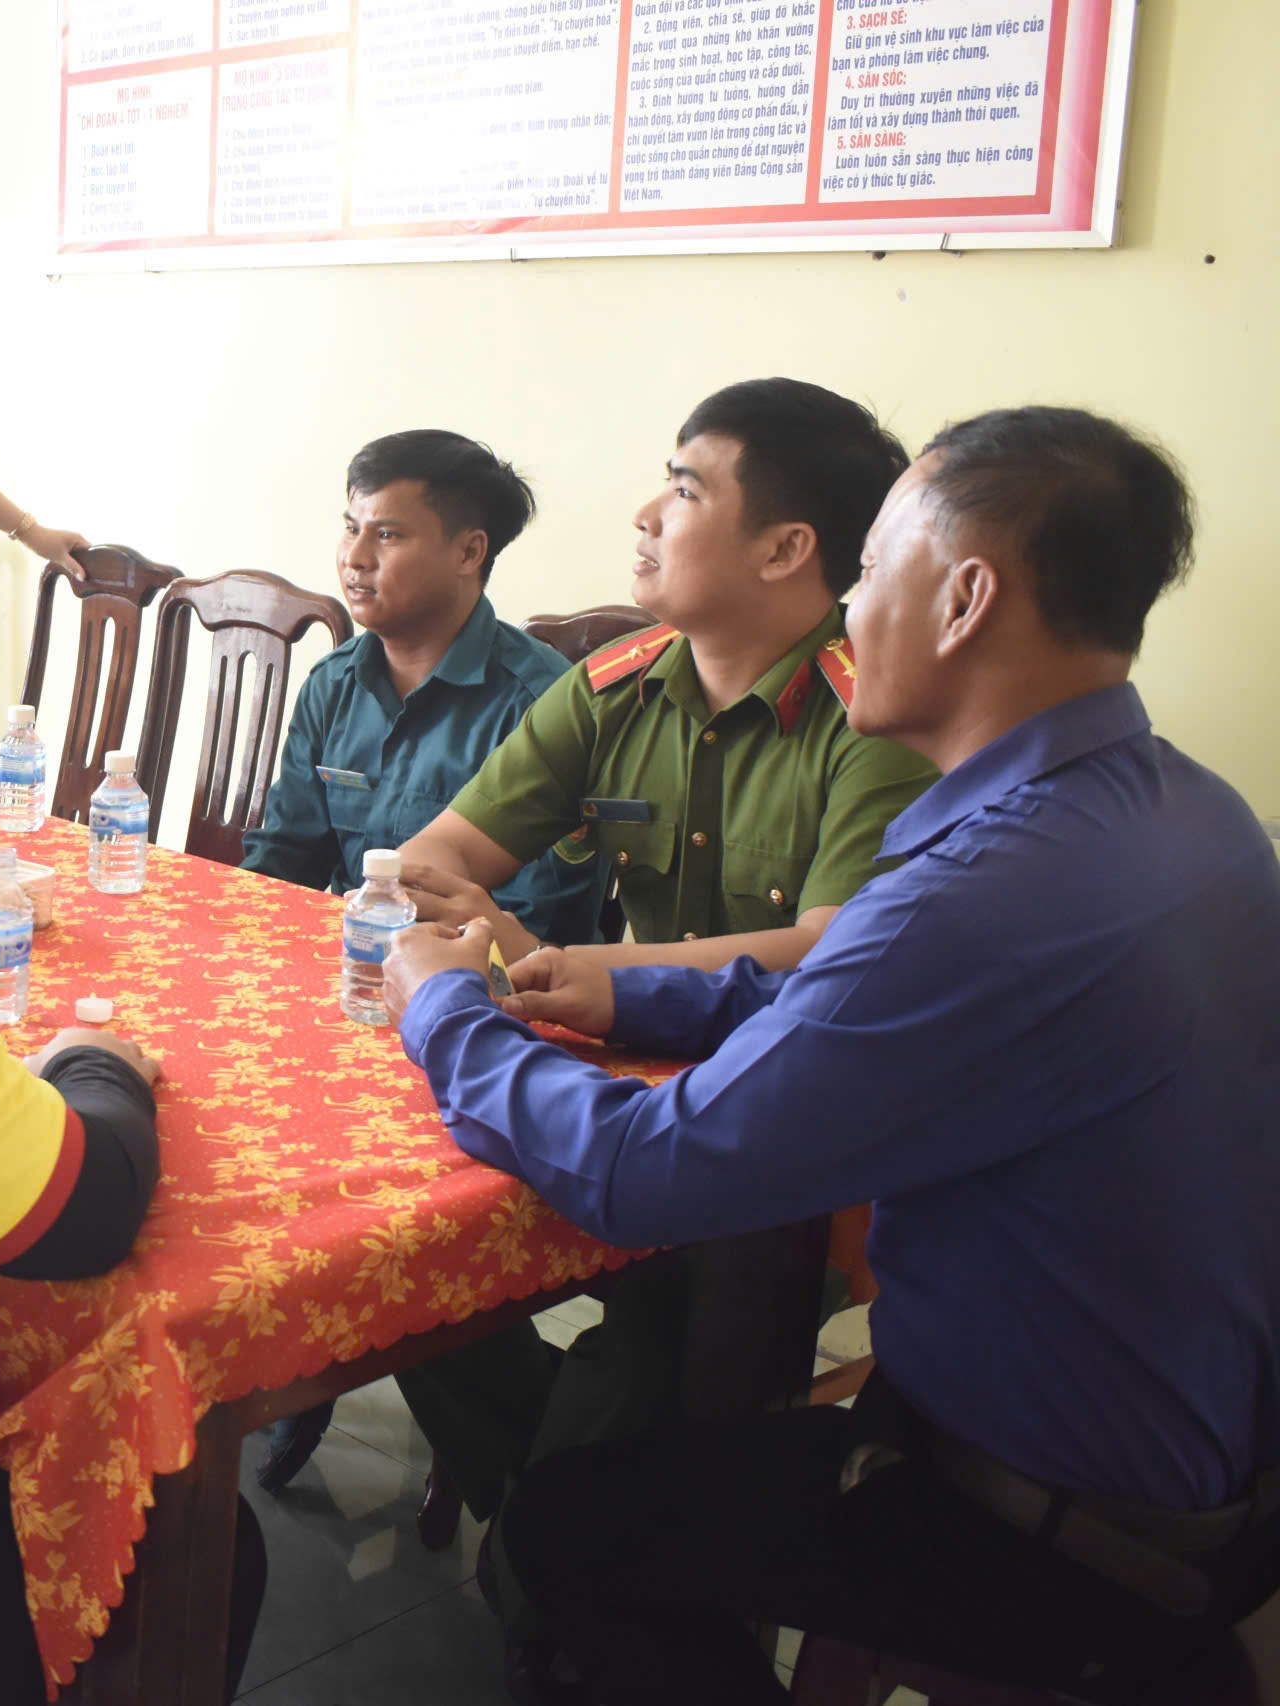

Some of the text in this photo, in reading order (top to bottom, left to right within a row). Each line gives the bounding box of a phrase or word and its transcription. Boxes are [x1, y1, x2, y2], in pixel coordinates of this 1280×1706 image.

[643, 21, 653, 34] 2.
[655, 18, 678, 35] Động
[682, 15, 703, 31] viên,
[707, 12, 727, 27] chia
[750, 8, 770, 25] giúp
[846, 8, 907, 32] 3. SẠCH SẼ:
[632, 39, 653, 56] phục
[681, 37, 697, 51] qua
[734, 28, 752, 43] khó
[844, 18, 1044, 50] Giữ gìn vệ sinh khu vực làm việc của
[653, 56, 675, 72] trong
[678, 53, 697, 67] sinh
[700, 50, 722, 68] hoạt,
[726, 48, 743, 65] học
[746, 47, 764, 63] tập,
[767, 44, 791, 61] công
[794, 42, 812, 58] tác,
[831, 44, 989, 74] bạn và phòng làm việc chung.
[630, 77, 650, 93] cuộc
[718, 68, 746, 85] chúng
[748, 67, 759, 80] và
[844, 69, 906, 90] 4. SĂN SÓC:
[639, 95, 648, 108] 3.
[840, 95, 859, 112] Duy
[863, 94, 874, 108] trì
[879, 91, 915, 110] thường
[919, 89, 952, 107] xuyên
[956, 86, 991, 104] những
[995, 84, 1019, 102] việc
[627, 114, 648, 129] hành
[650, 112, 674, 129] động,
[676, 111, 691, 127] xây
[693, 109, 715, 126] dựng
[717, 107, 739, 124] động
[779, 101, 800, 118] đấu,
[827, 116, 846, 131] làm
[865, 114, 877, 128] và
[880, 113, 899, 129] xây
[901, 110, 928, 128] dựng
[931, 108, 962, 124] thành
[964, 107, 986, 122] thói
[988, 108, 1020, 123] quen.
[626, 133, 640, 146] chí
[667, 130, 684, 143] tâm
[709, 127, 724, 141] lên
[726, 126, 750, 142] trong
[752, 124, 775, 140] công
[777, 123, 792, 136] tác
[795, 122, 806, 135] và
[836, 130, 906, 151] 5. SẴN SÀNG:
[625, 151, 646, 167] cuộc
[670, 148, 686, 161] cho
[711, 144, 739, 161] chúng
[753, 143, 769, 159] đạt
[770, 141, 804, 158] nguyện
[835, 147, 1033, 170] Luôn luôn sẵn sàng thực hiện công
[661, 160, 803, 182] thành đảng viên Đảng Cộng sản
[822, 172, 936, 193] việc có ý thức tự giác.
[640, 187, 663, 200] Nam.
